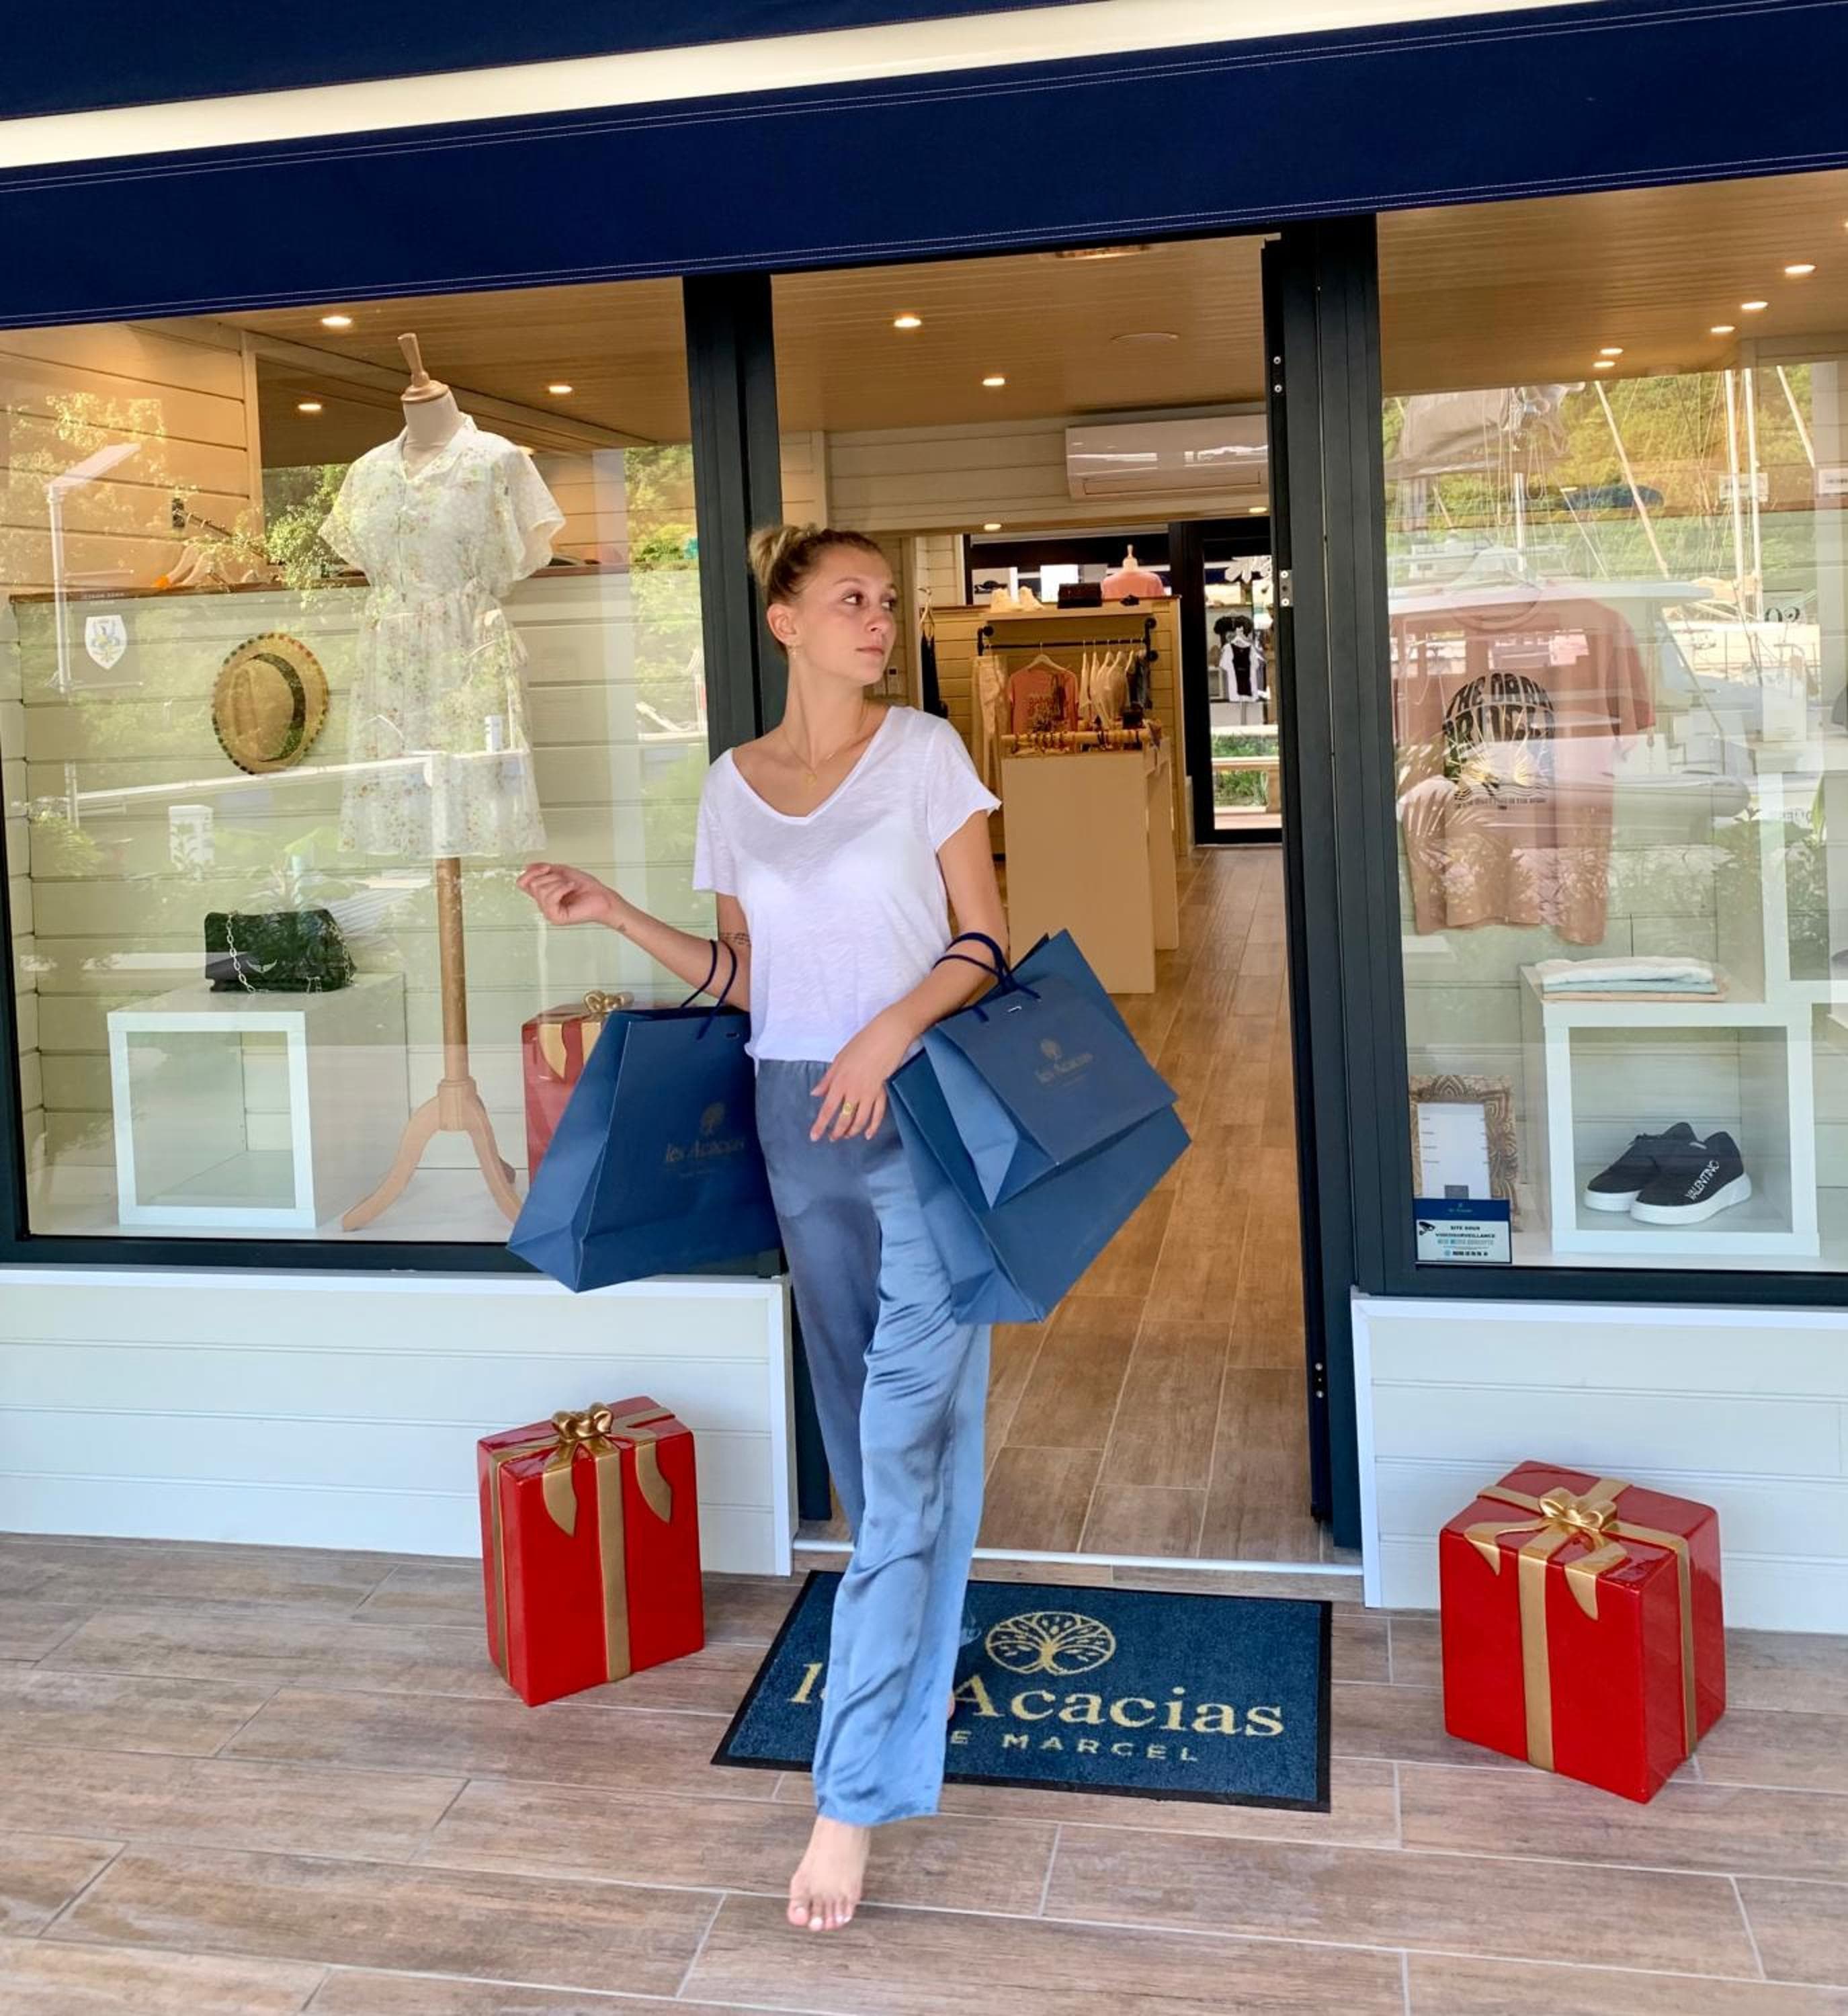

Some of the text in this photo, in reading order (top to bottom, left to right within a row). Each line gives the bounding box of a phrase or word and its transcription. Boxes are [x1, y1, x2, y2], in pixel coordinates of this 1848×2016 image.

[1685, 1160, 1720, 1200] VALENTINO
[953, 1673, 1284, 1736] Acacias
[1001, 1733, 1198, 1761] MARCEL
